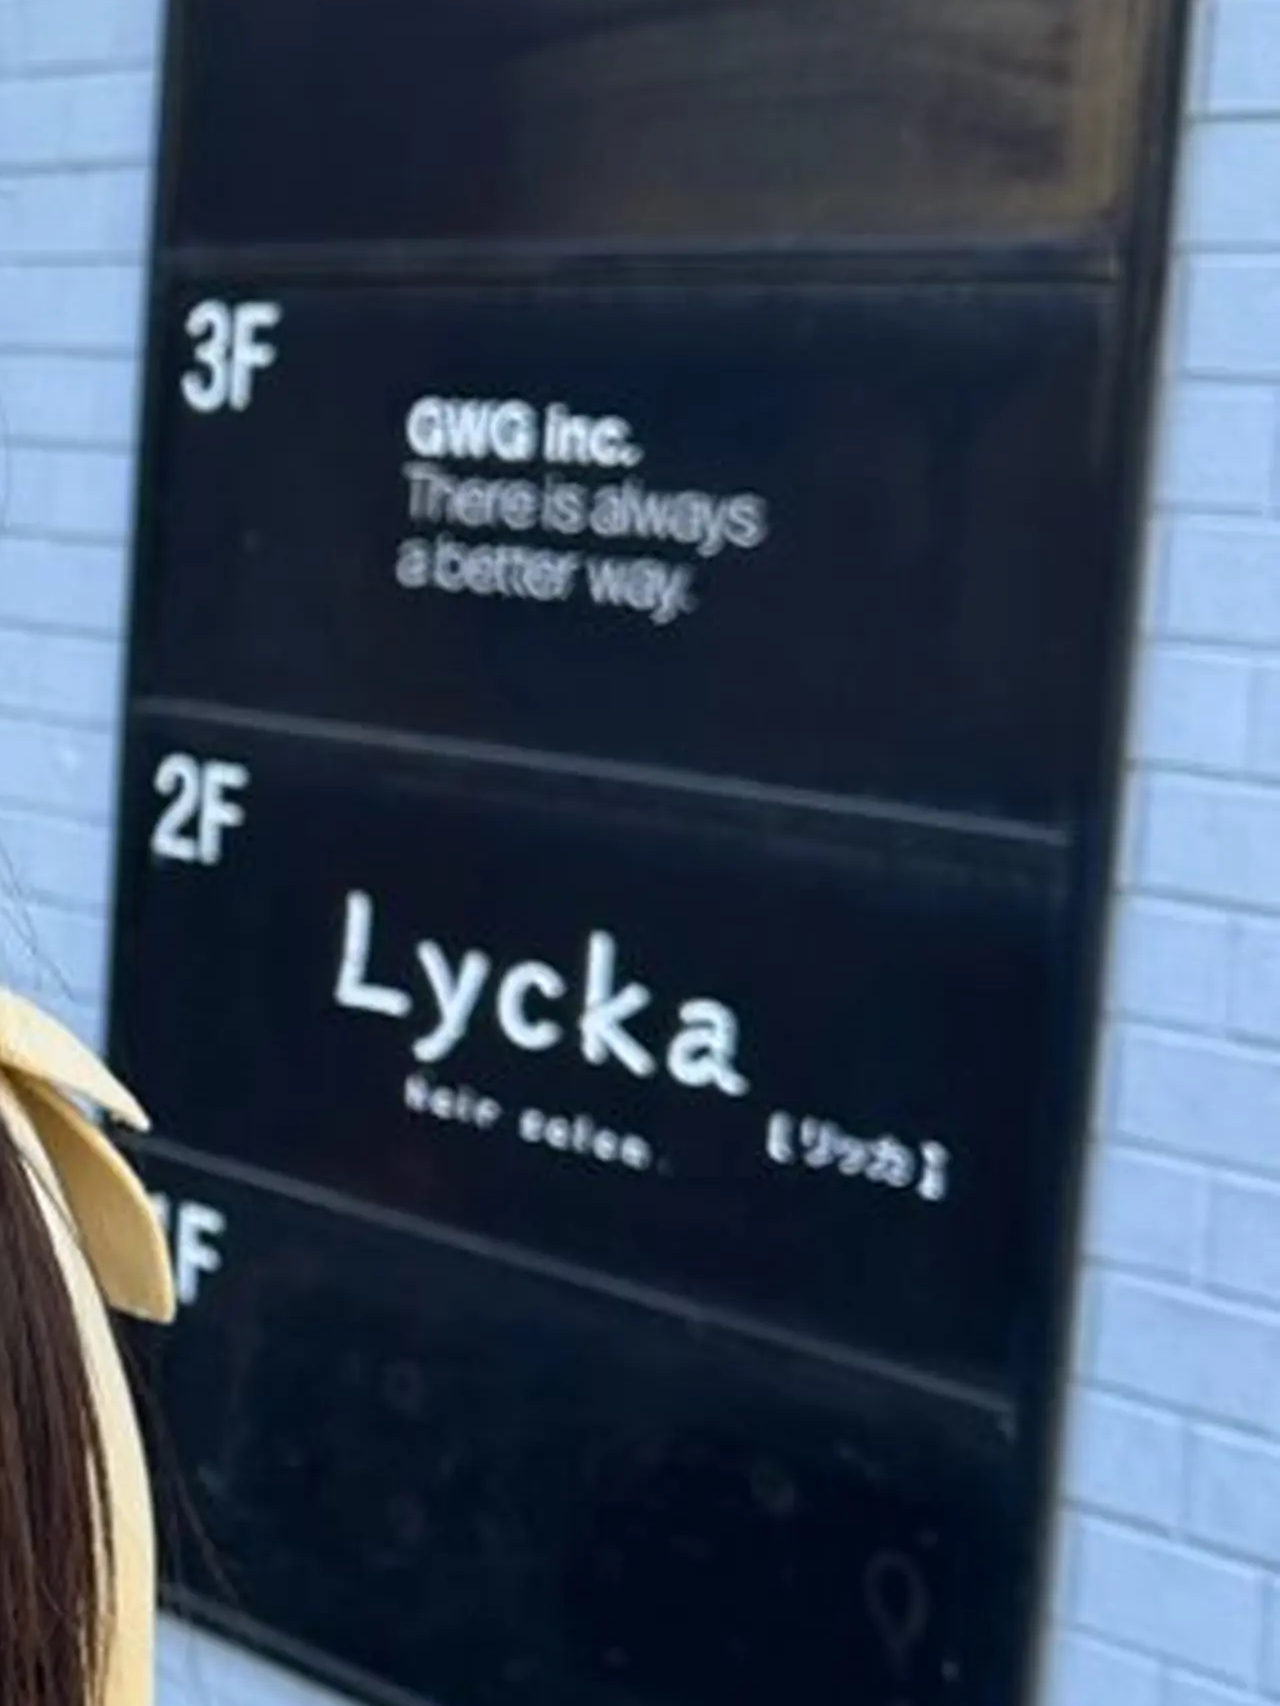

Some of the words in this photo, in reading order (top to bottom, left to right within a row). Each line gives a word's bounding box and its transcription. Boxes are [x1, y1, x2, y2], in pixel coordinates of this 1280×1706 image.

[179, 299, 282, 413] 3F
[406, 395, 538, 463] GWG
[402, 461, 540, 531] There
[542, 469, 588, 536] is
[590, 473, 769, 559] always
[395, 535, 430, 589] a
[433, 531, 580, 602] better
[152, 751, 248, 865] 2F
[332, 889, 752, 1097] Lycka
